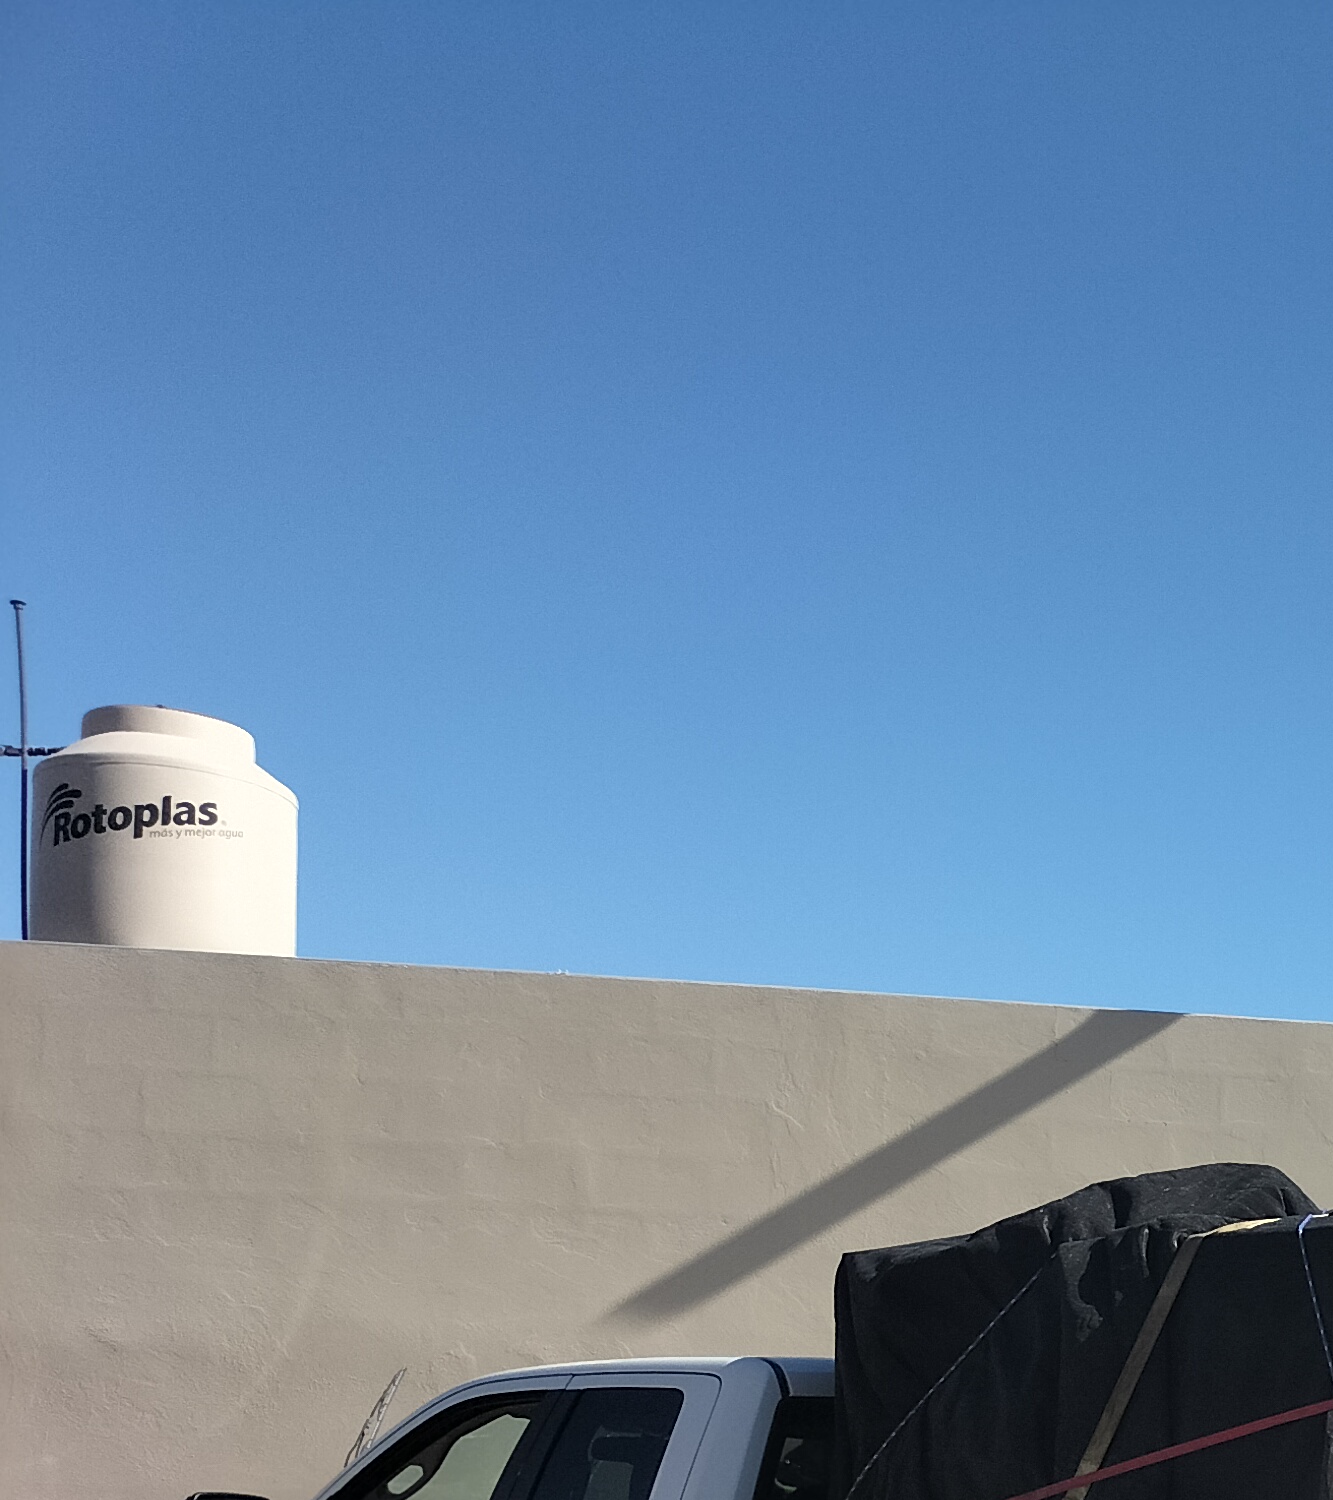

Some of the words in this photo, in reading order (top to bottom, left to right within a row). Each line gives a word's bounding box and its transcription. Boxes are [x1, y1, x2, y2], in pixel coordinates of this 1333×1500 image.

[53, 795, 218, 847] Rotoplas
[150, 829, 173, 839] más
[175, 829, 182, 840] y
[184, 826, 215, 839] mejor
[218, 830, 244, 840] agua
